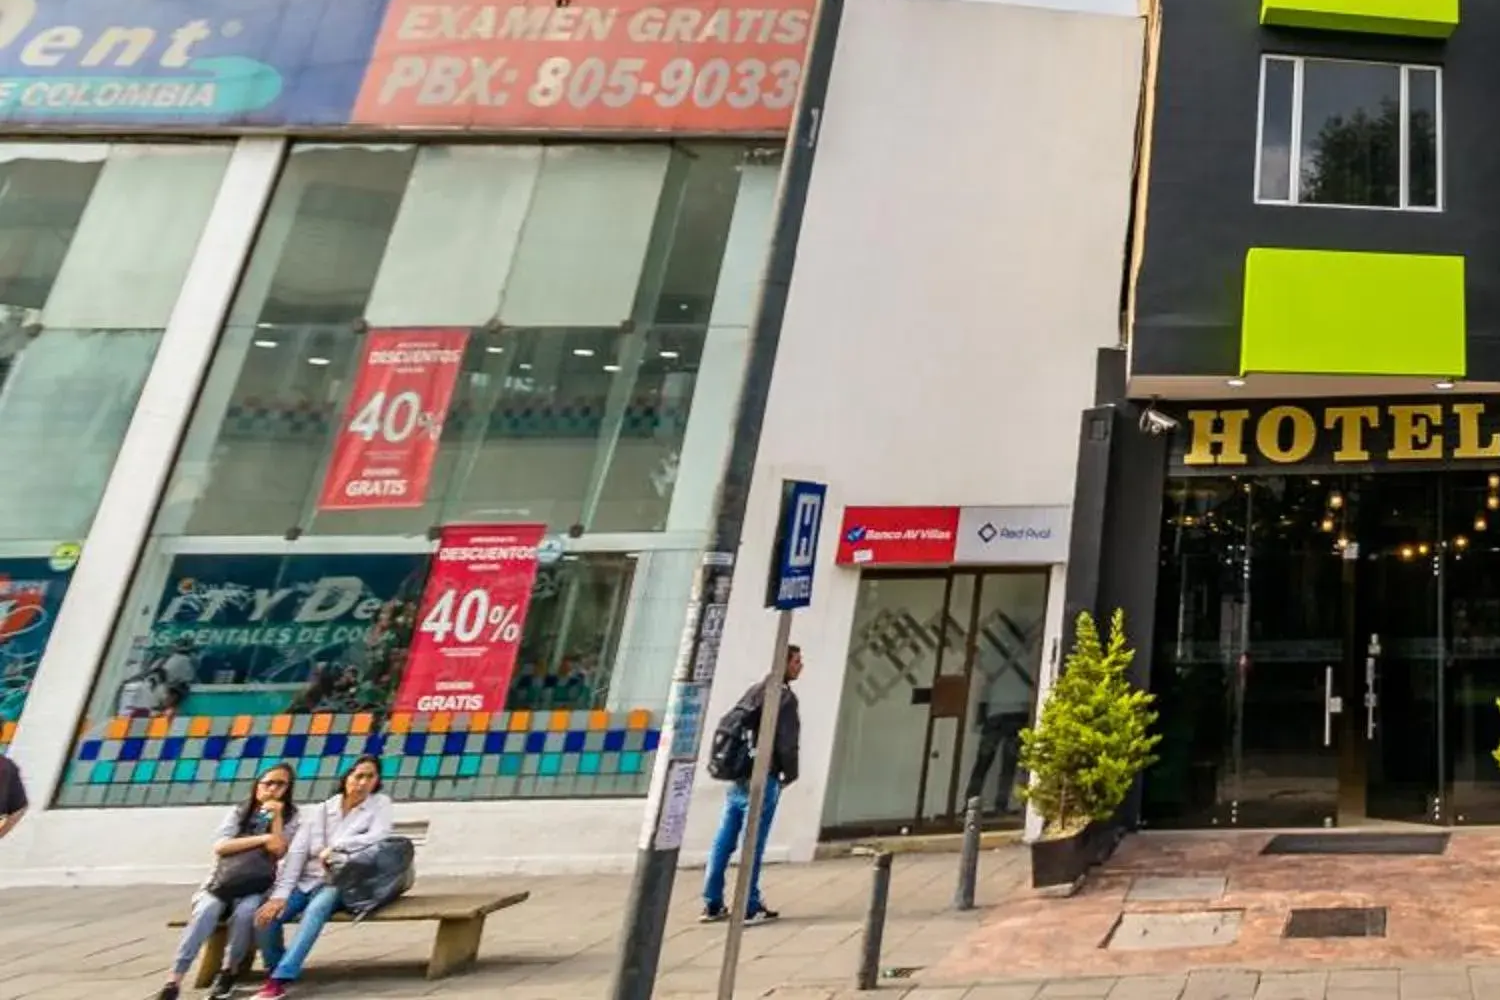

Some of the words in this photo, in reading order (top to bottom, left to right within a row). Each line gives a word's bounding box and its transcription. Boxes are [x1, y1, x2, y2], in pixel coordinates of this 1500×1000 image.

[398, 5, 616, 41] EXAMEN
[627, 6, 808, 43] GRATIS
[20, 80, 217, 107] COLOMBIA
[377, 56, 518, 105] PBX:
[526, 56, 801, 107] 805-9033
[345, 480, 408, 496] GRATIS
[865, 529, 902, 540] Banco
[778, 576, 811, 601] HOTEL
[420, 589, 519, 643] 40%
[417, 695, 484, 711] GRATIS
